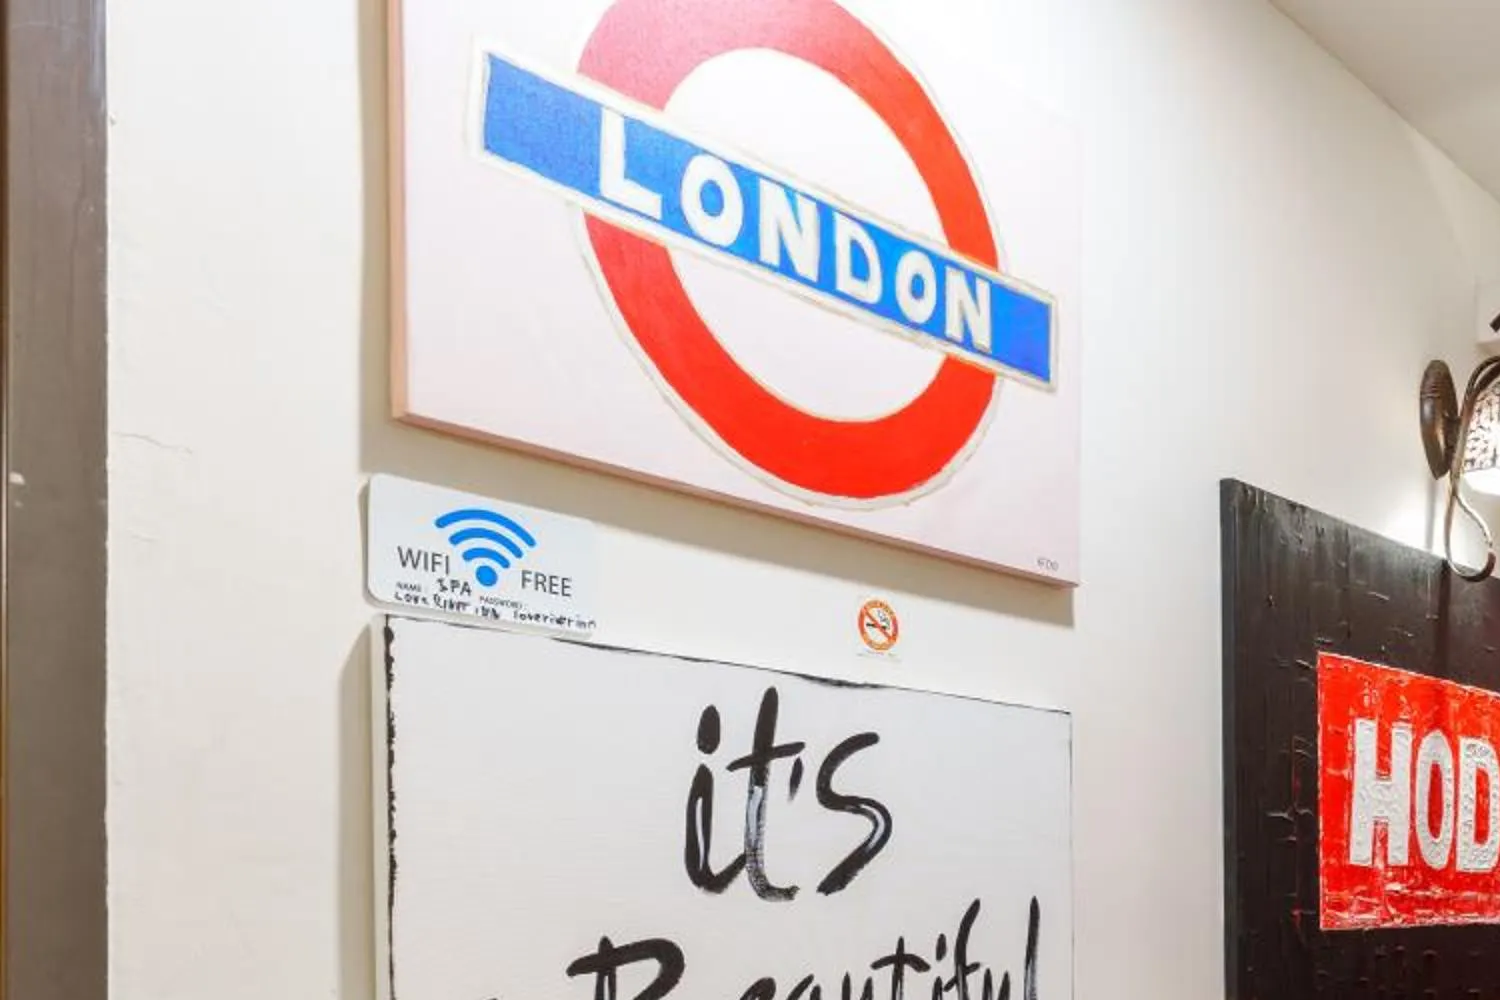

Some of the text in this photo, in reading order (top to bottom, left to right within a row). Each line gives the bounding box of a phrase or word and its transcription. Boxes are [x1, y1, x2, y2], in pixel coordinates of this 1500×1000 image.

[599, 103, 993, 354] LONDON
[397, 545, 450, 575] WIFI
[521, 569, 572, 597] FREE
[684, 686, 892, 901] it's
